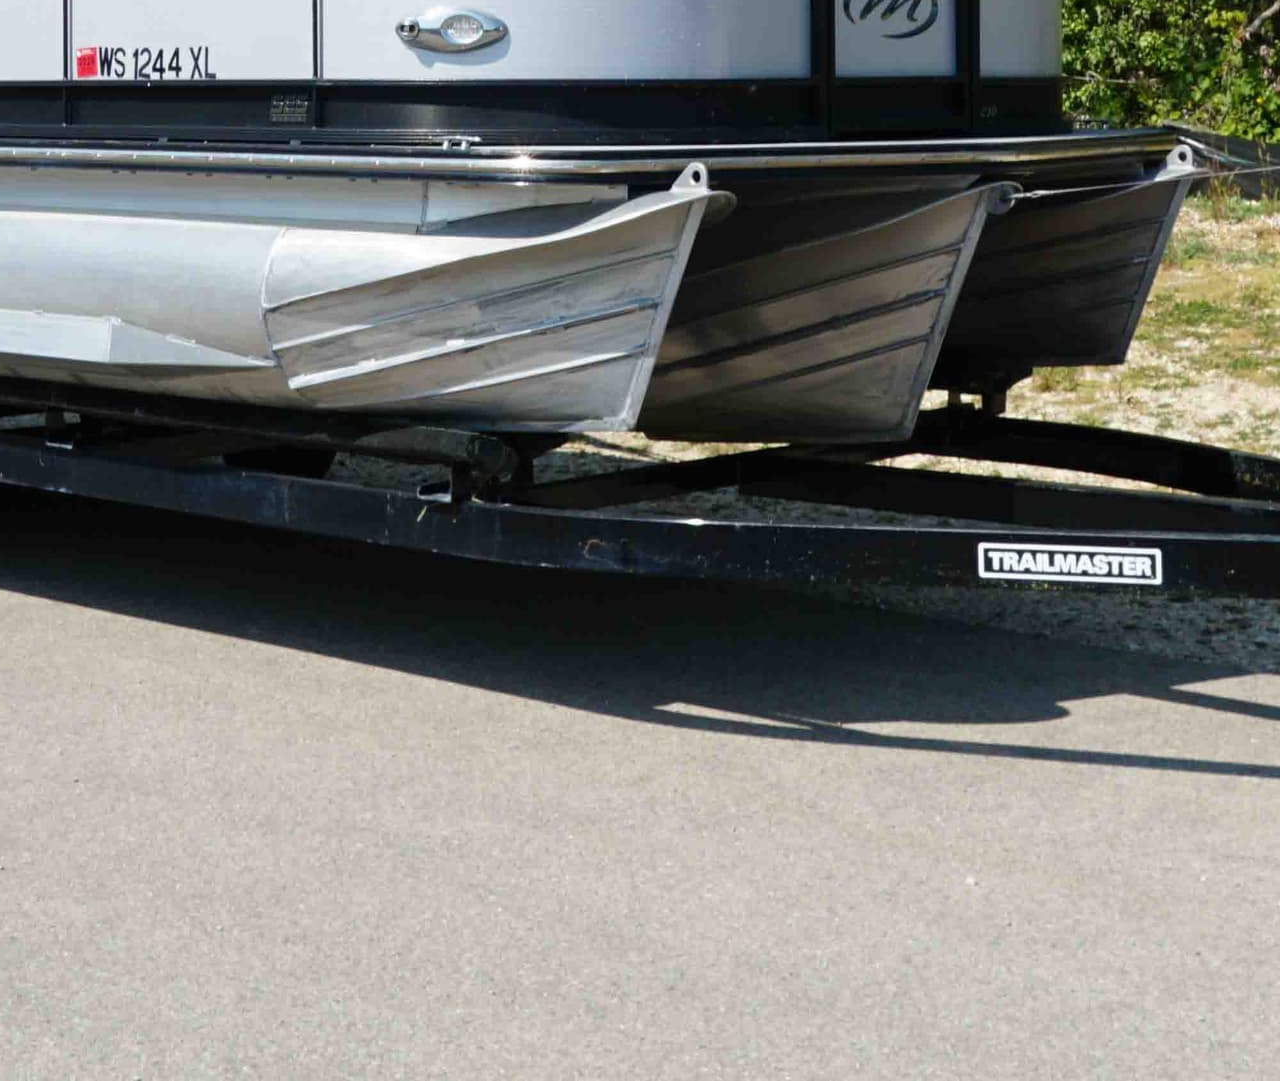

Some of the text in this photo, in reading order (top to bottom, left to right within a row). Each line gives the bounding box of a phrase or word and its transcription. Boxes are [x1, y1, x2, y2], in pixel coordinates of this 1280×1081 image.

[99, 46, 126, 78] WS
[132, 47, 182, 80] 1244
[189, 46, 217, 79] XL
[987, 551, 1153, 577] TRAILMASTER
